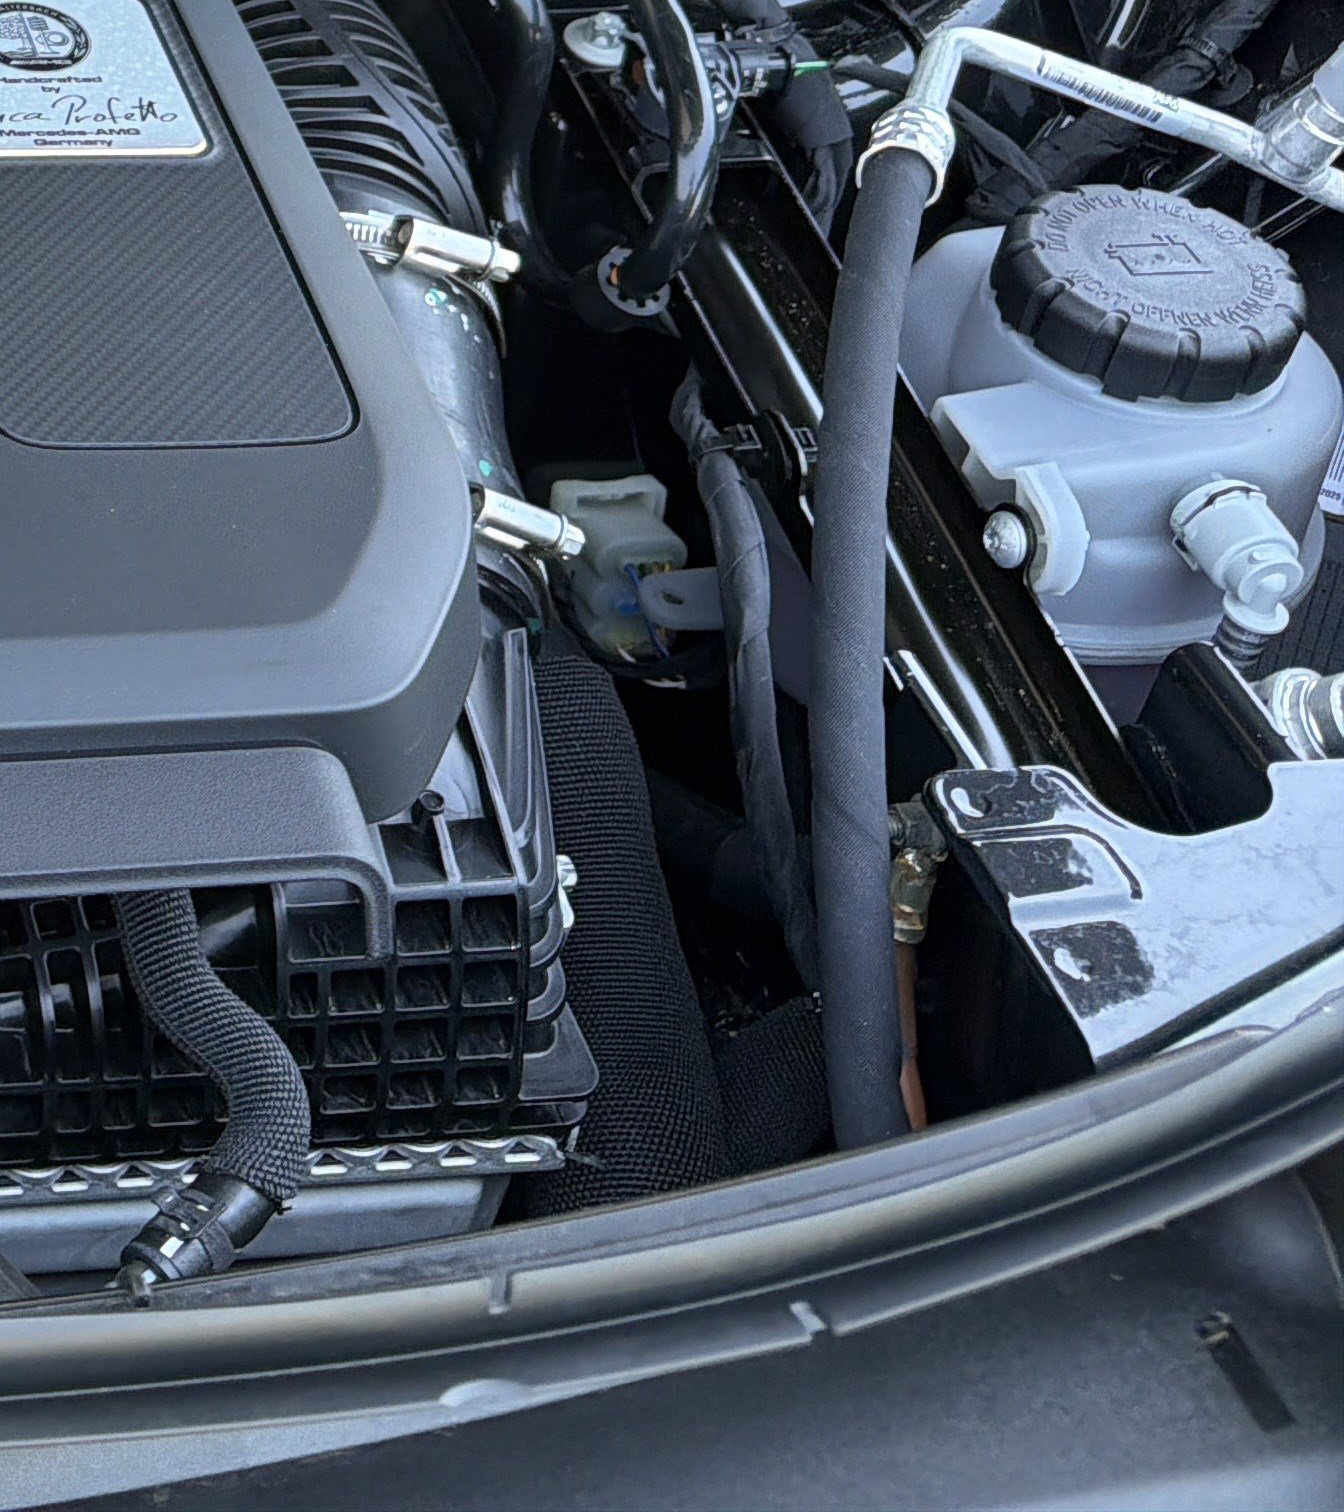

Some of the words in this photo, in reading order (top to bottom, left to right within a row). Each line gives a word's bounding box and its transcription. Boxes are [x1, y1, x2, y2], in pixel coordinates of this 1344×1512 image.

[41, 85, 61, 95] by
[34, 138, 114, 148] Germany
[1072, 194, 1126, 215] OPEN
[1130, 190, 1198, 223] WHEN
[1202, 220, 1249, 247] HOT
[1067, 268, 1129, 307] NICHT
